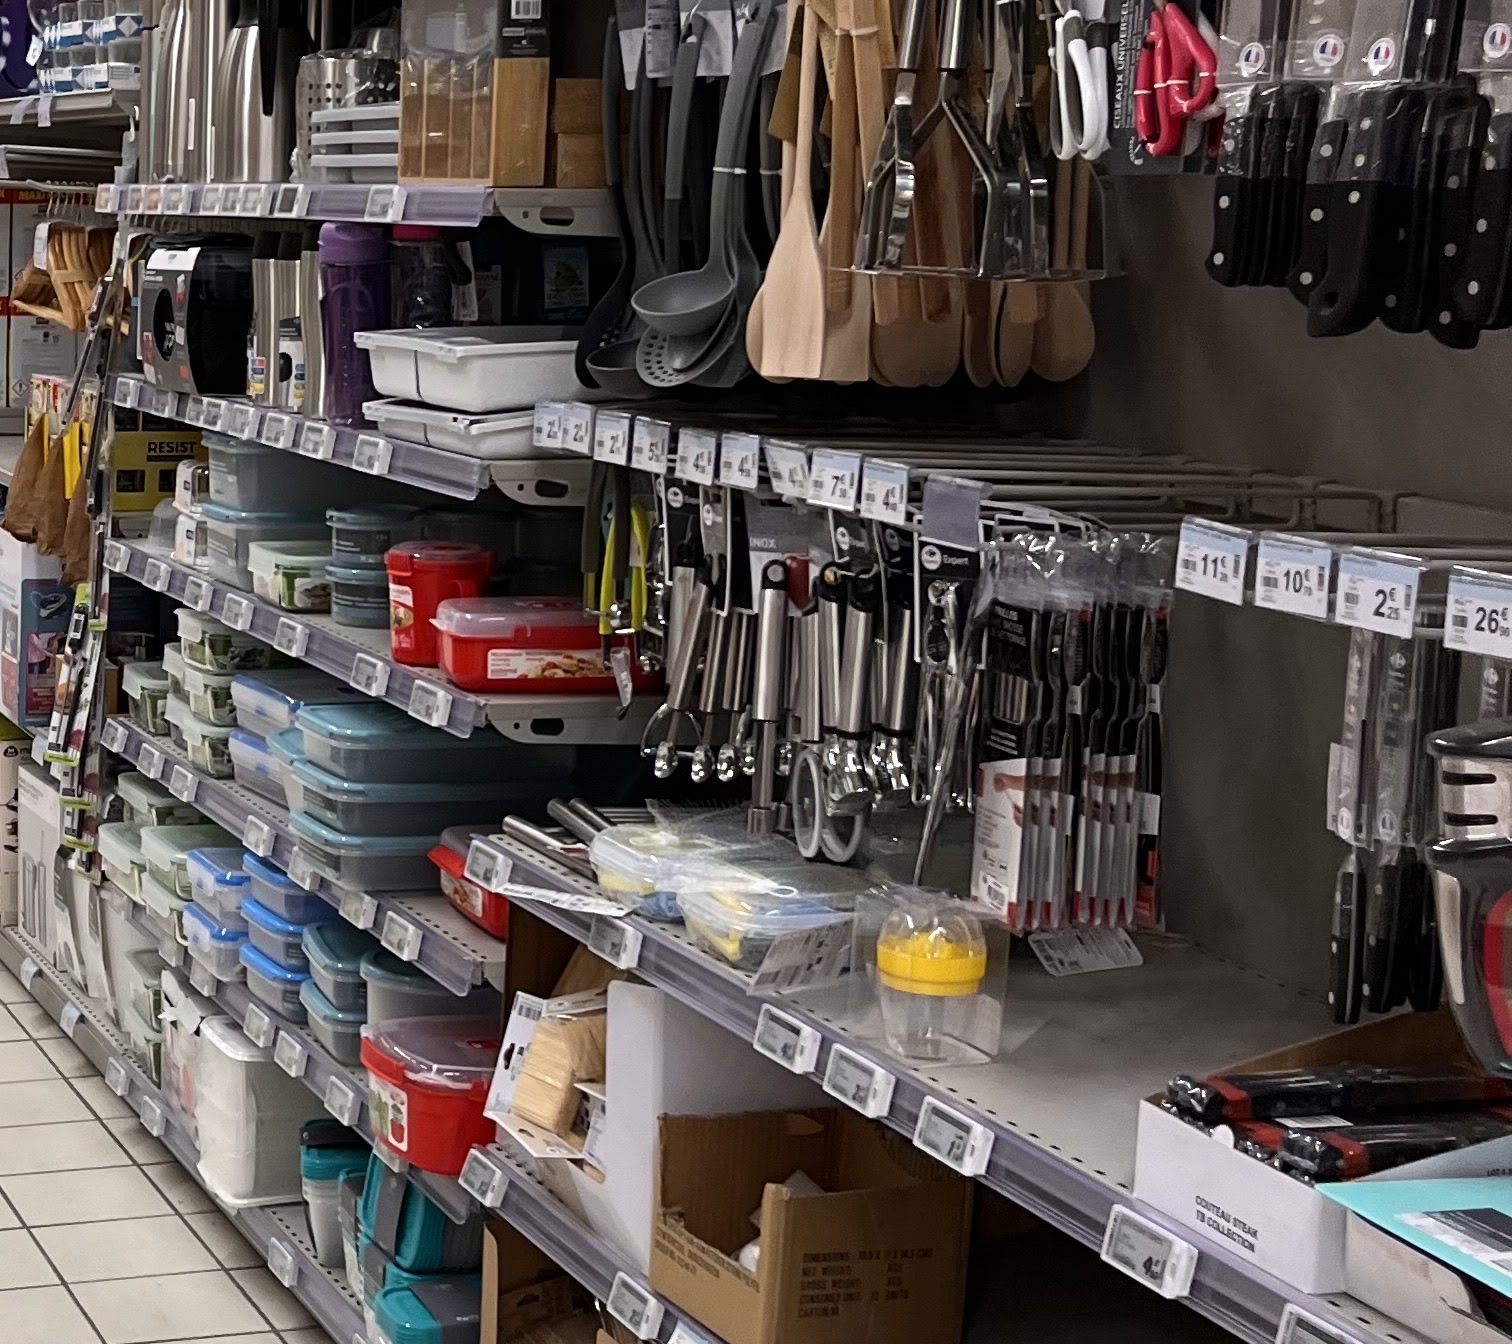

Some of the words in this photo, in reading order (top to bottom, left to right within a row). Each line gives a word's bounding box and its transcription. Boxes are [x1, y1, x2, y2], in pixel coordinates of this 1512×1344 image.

[1117, 0, 1131, 72] UNIVERSEL
[1113, 74, 1127, 130] CISEAUX
[147, 441, 197, 454] RESIST
[749, 537, 777, 549] INOX
[1195, 1195, 1231, 1224] COUTEAU
[1206, 1216, 1255, 1253] COLLECTION
